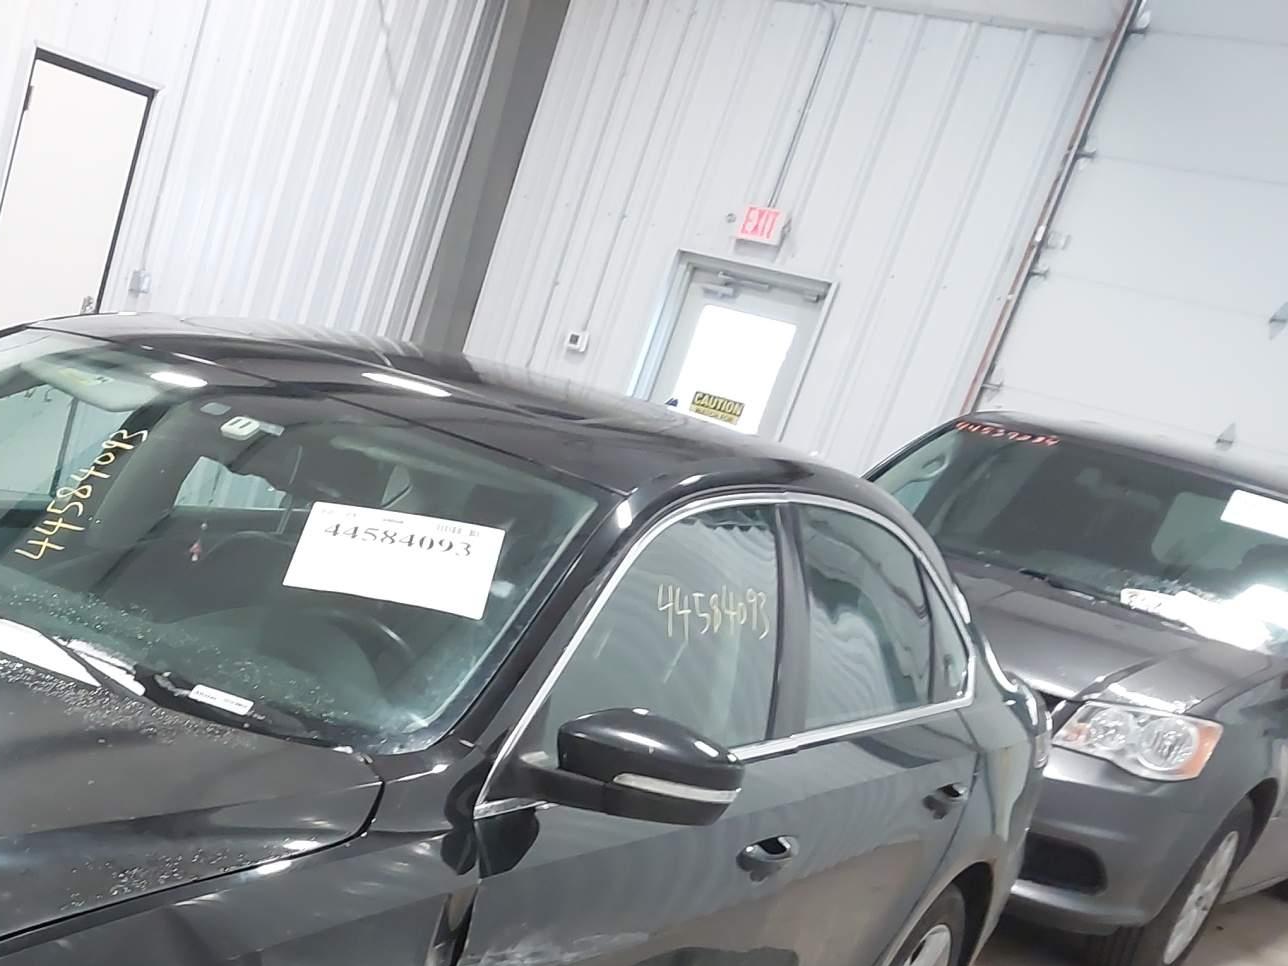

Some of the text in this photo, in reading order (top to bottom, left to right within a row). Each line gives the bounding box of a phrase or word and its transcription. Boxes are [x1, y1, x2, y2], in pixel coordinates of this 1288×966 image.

[742, 207, 781, 239] EXIT
[694, 392, 743, 416] CAUTION
[14, 429, 148, 560] 44584093
[324, 523, 472, 557] 44584093
[657, 583, 770, 641] 44584093
